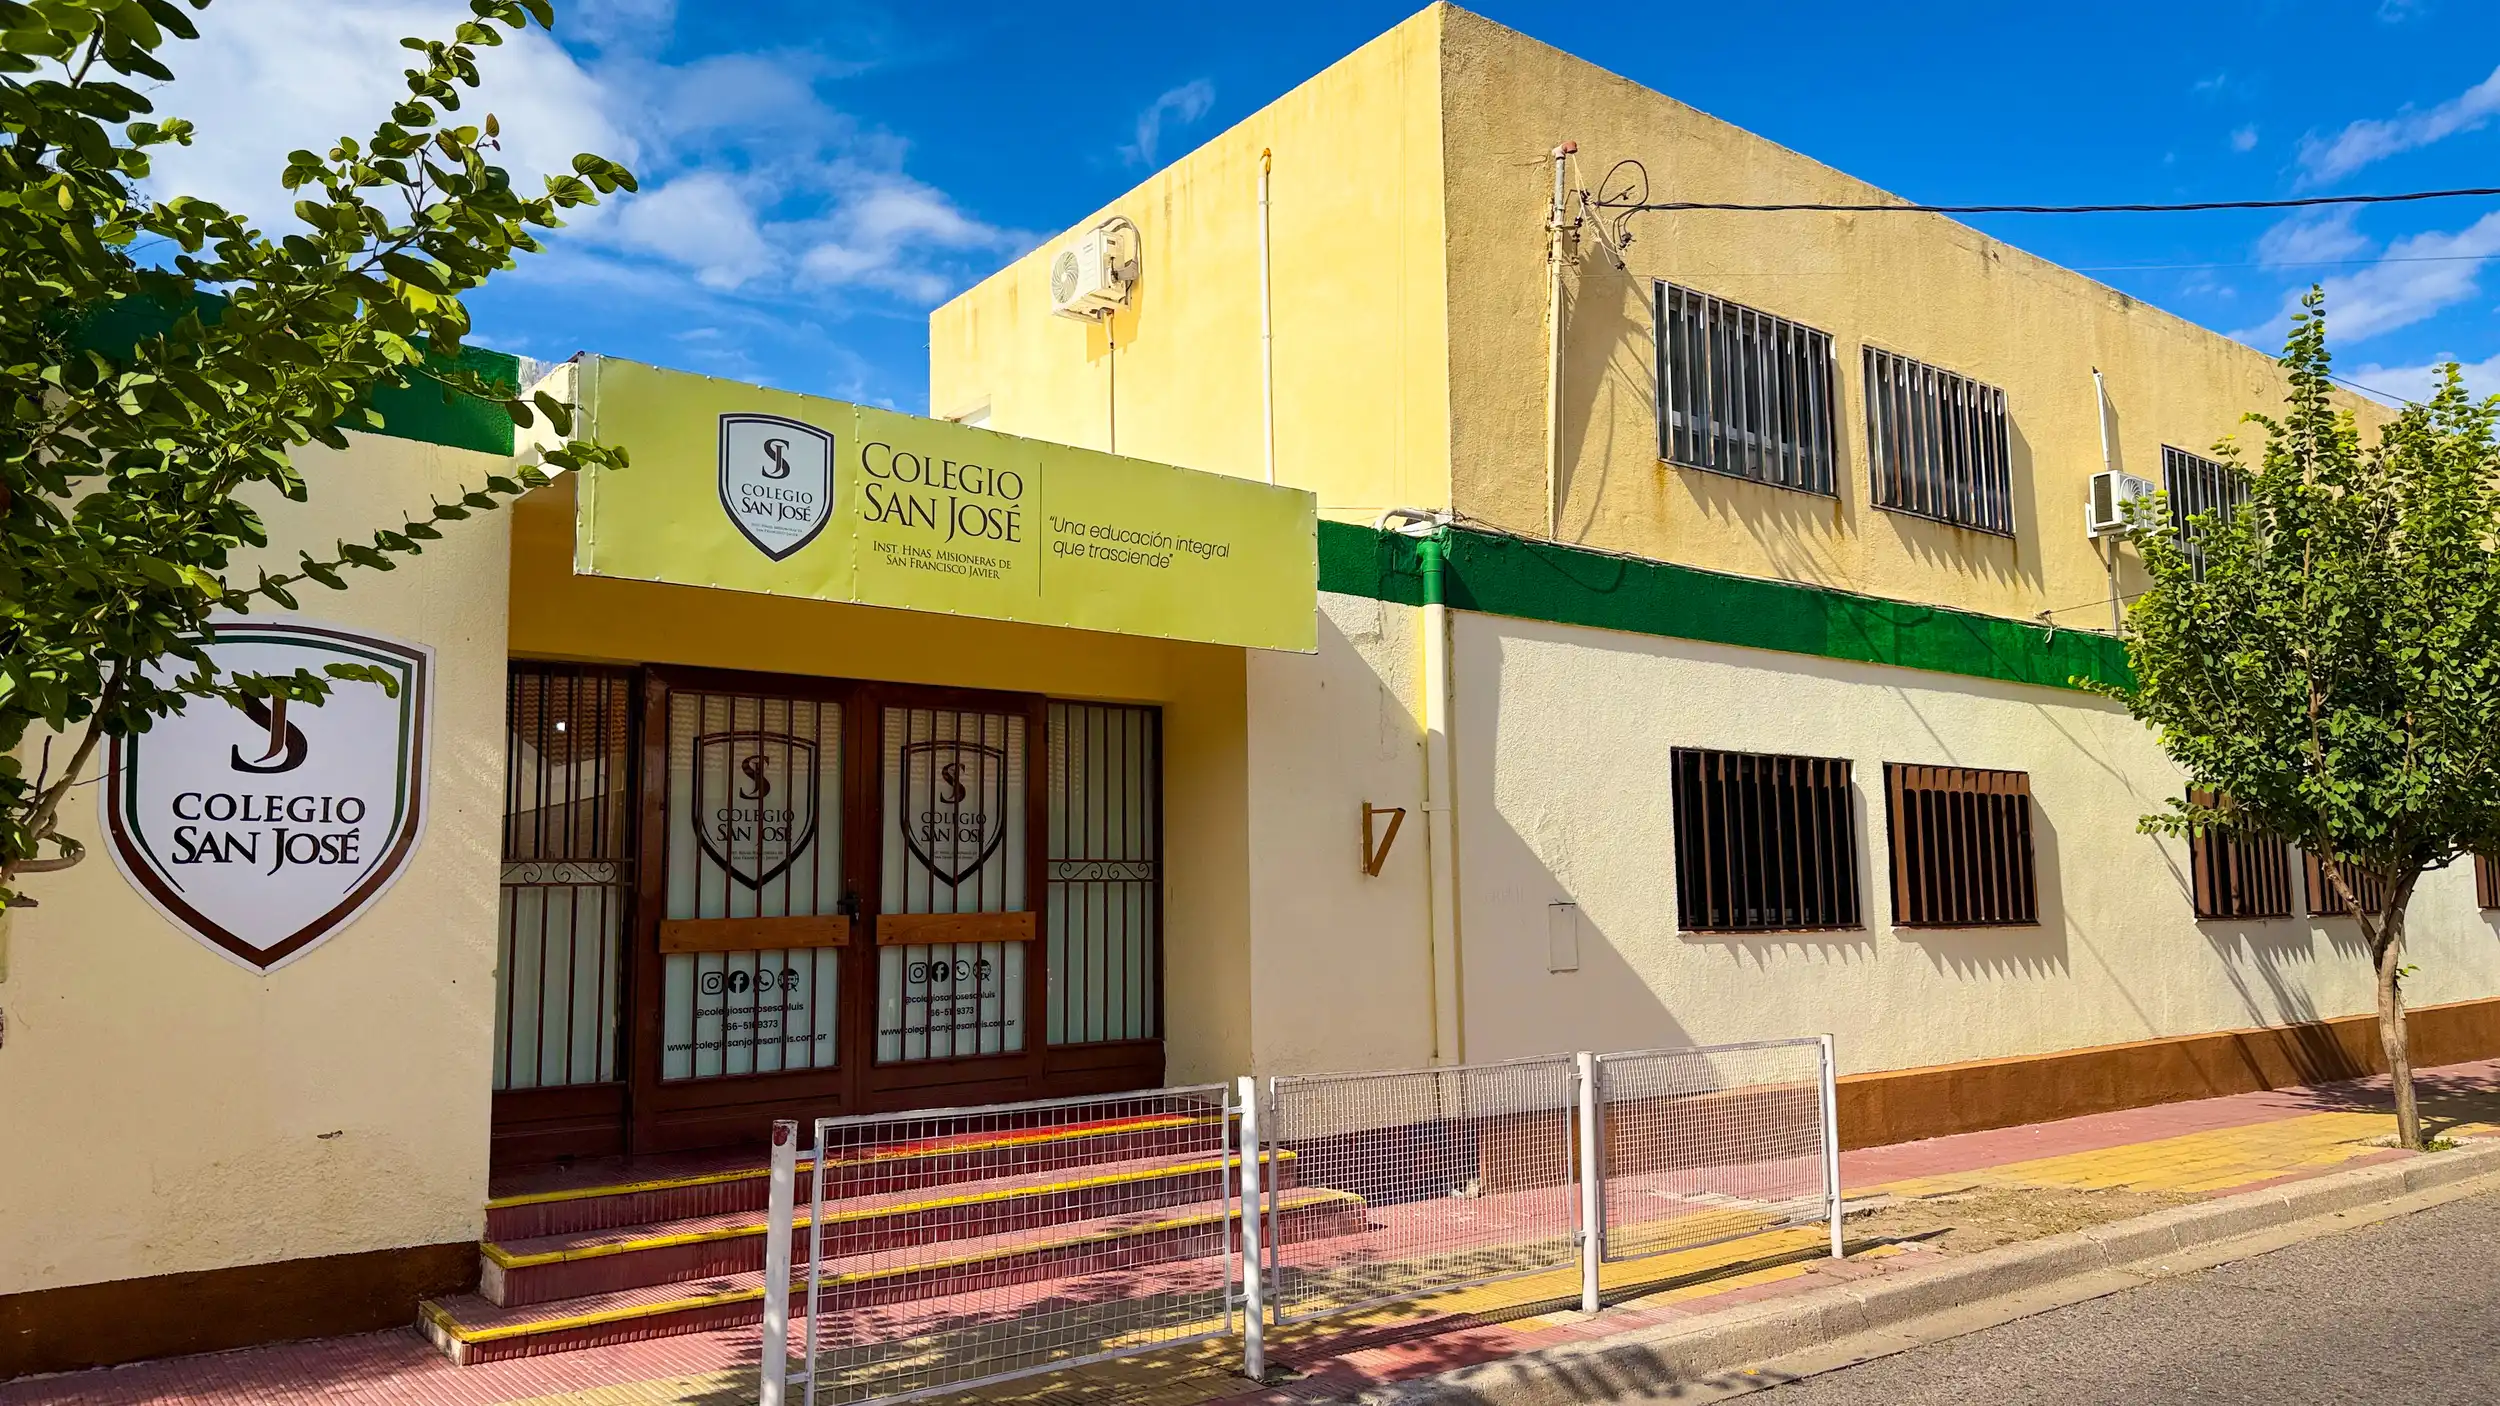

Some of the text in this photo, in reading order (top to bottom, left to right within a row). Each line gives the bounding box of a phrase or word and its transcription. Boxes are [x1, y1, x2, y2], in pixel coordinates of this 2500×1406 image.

[862, 442, 1023, 501] COLEGIO
[741, 483, 813, 504] COLEGIO
[741, 497, 811, 522] SAN JOSÉ
[864, 483, 1021, 543] SAN JOSÉ
[1053, 540, 1085, 558] que
[1089, 524, 1172, 549] educación
[1175, 535, 1230, 560] integral
[886, 554, 1001, 580] SAN FRANCISCO JAVIER
[936, 550, 996, 568] MISIONERAS
[999, 559, 1012, 570] DE
[172, 792, 366, 824] COLEGIO
[716, 808, 795, 822] COLEGIO
[756, 825, 793, 846] OS
[955, 827, 984, 844] OS
[171, 825, 360, 876] SAN JOSÉ
[696, 1002, 804, 1018] @coleiosanosesaluis
[721, 1020, 779, 1031] 66-519373
